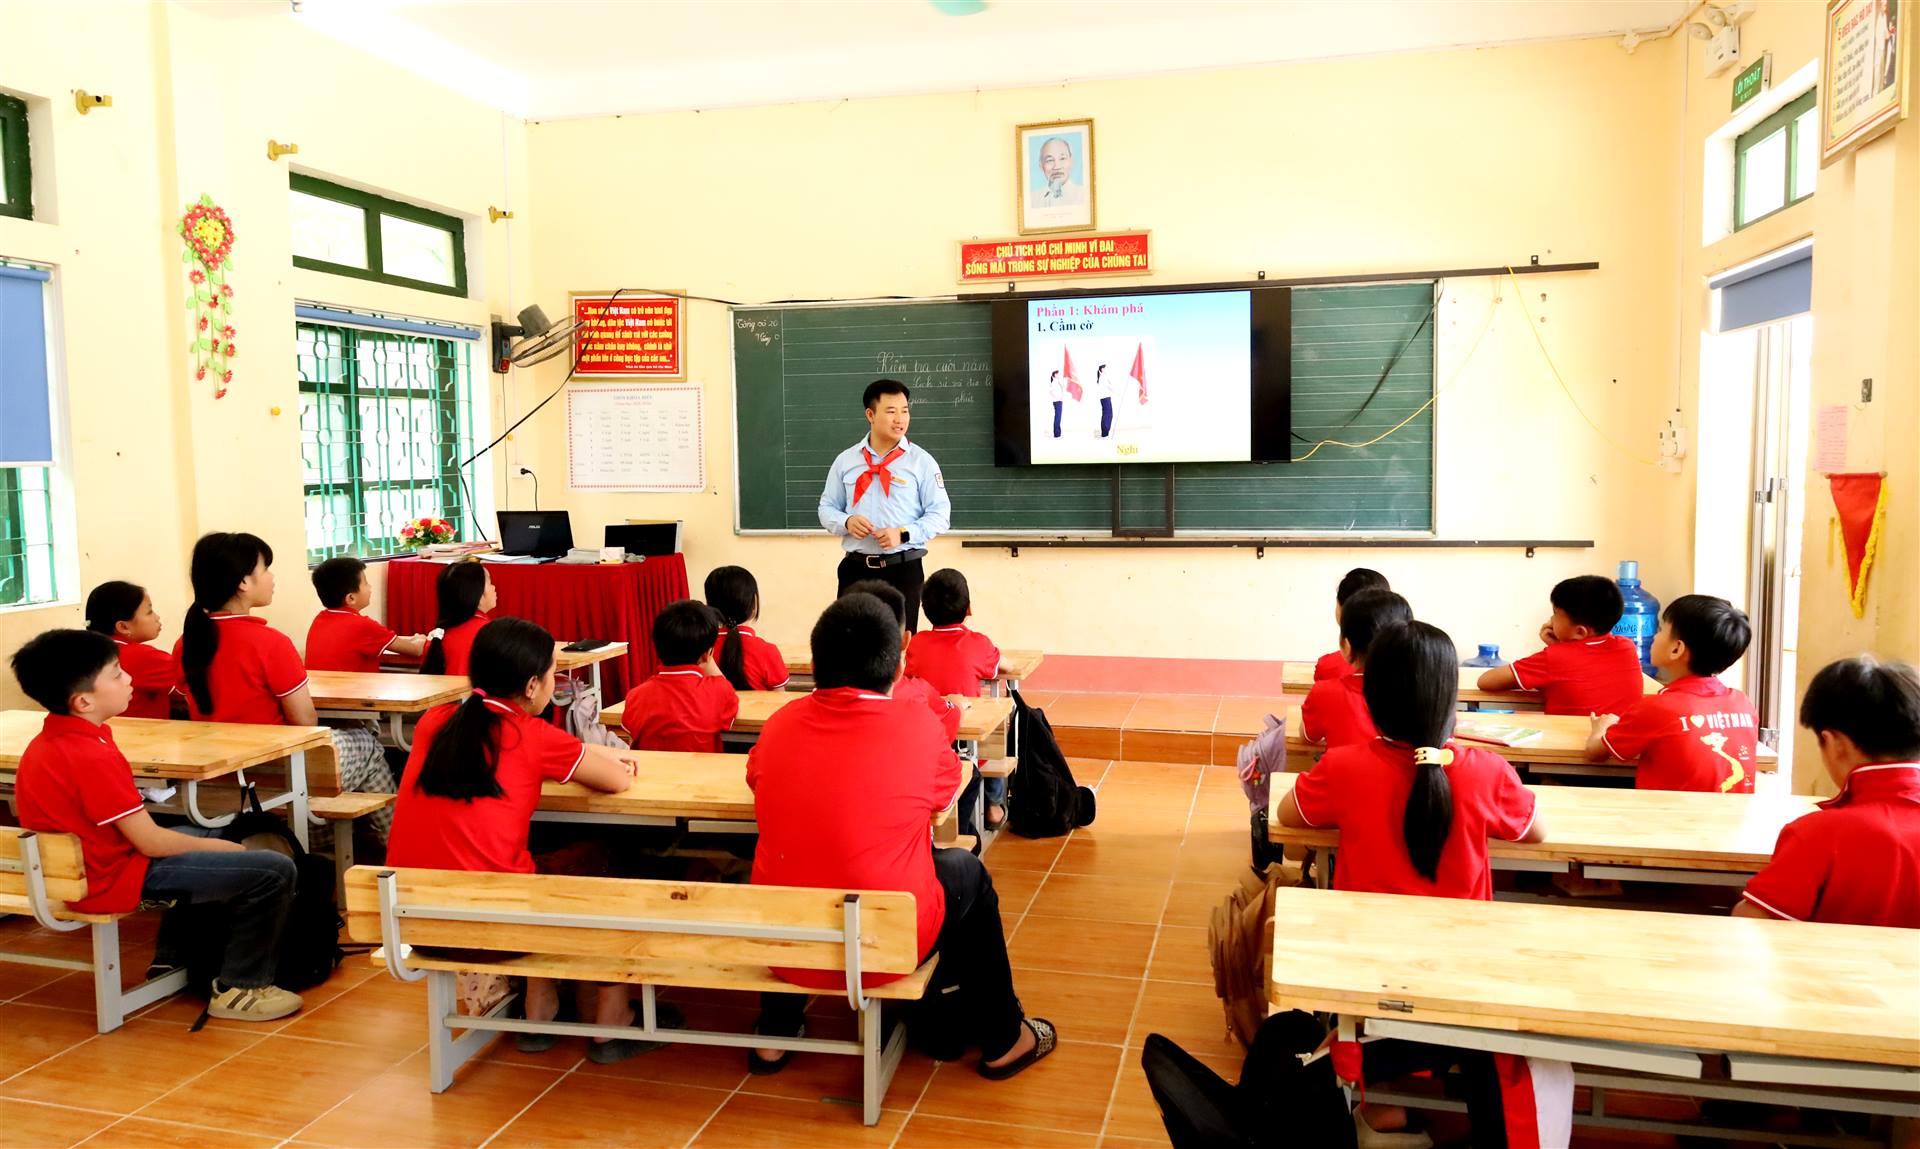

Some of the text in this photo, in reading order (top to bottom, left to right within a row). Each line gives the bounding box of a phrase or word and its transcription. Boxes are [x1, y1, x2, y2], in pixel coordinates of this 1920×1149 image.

[996, 242, 1013, 258] CHỦ
[1014, 244, 1034, 260] TỊCH
[1035, 241, 1047, 256] HỒ
[1049, 241, 1063, 255] CHÍ
[1065, 241, 1087, 254] MINH
[1099, 240, 1114, 255] ĐẠI
[965, 260, 988, 275] SỐNG
[990, 259, 1006, 274] MÃI
[1007, 260, 1035, 273] TRONG
[1037, 258, 1049, 274] SỰ
[1050, 256, 1081, 273] NGHIỆP
[1082, 253, 1100, 269] CỦA
[1102, 253, 1131, 268] CHÚNG
[1036, 303, 1144, 317] Phần 1: Khám phá
[1037, 318, 1094, 332] 1. Cầm cờ
[963, 360, 989, 372] năm
[1680, 716, 1691, 732] I
